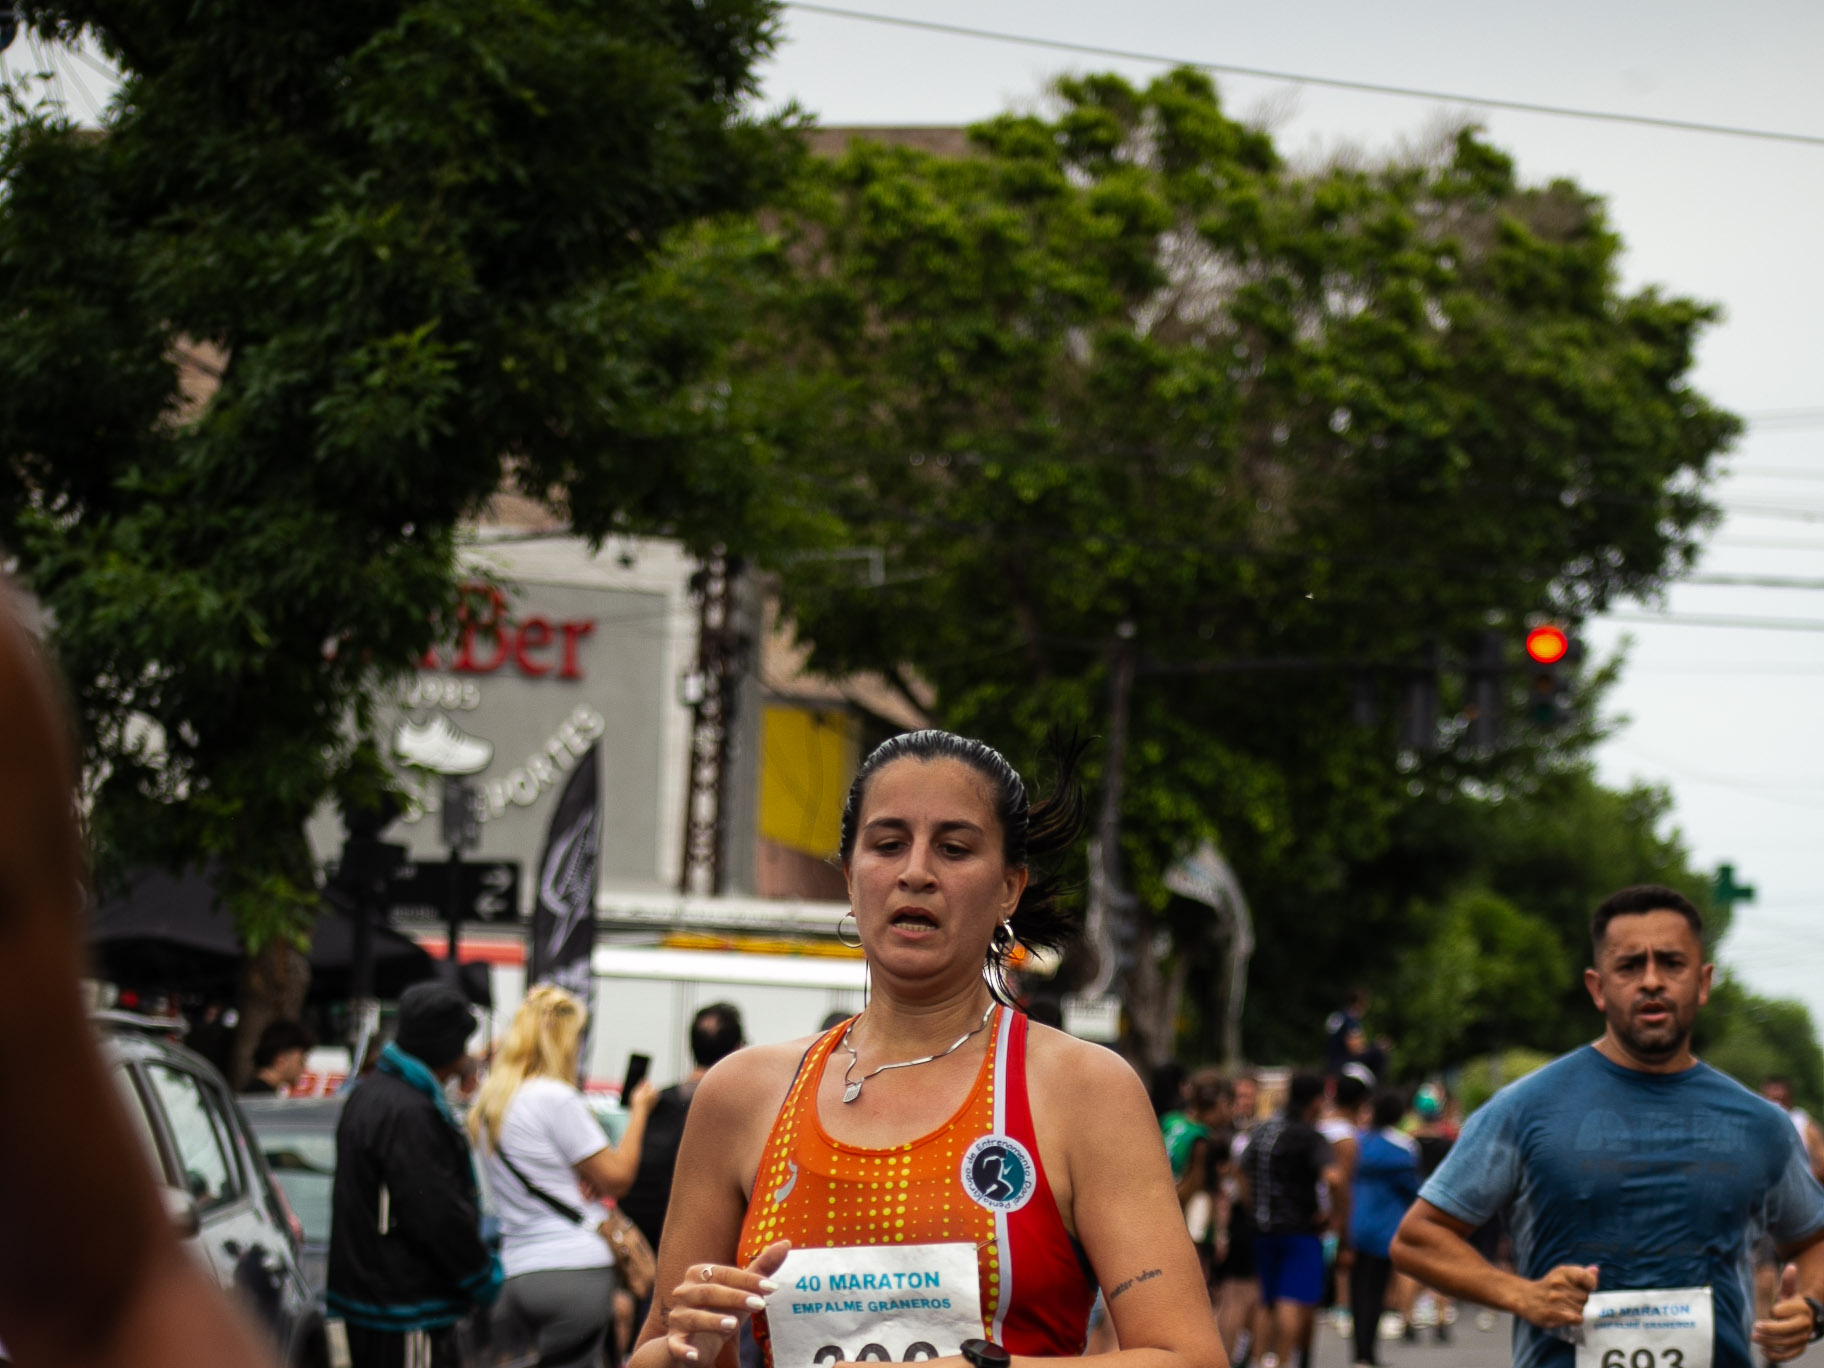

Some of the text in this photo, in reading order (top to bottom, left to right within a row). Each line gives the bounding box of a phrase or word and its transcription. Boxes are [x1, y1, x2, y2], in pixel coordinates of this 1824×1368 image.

[966, 1152, 977, 1164] de
[795, 1271, 941, 1292] 40 MARATON
[791, 1298, 952, 1315] EMPALME GRANEROS
[1619, 1304, 1690, 1317] MARATON
